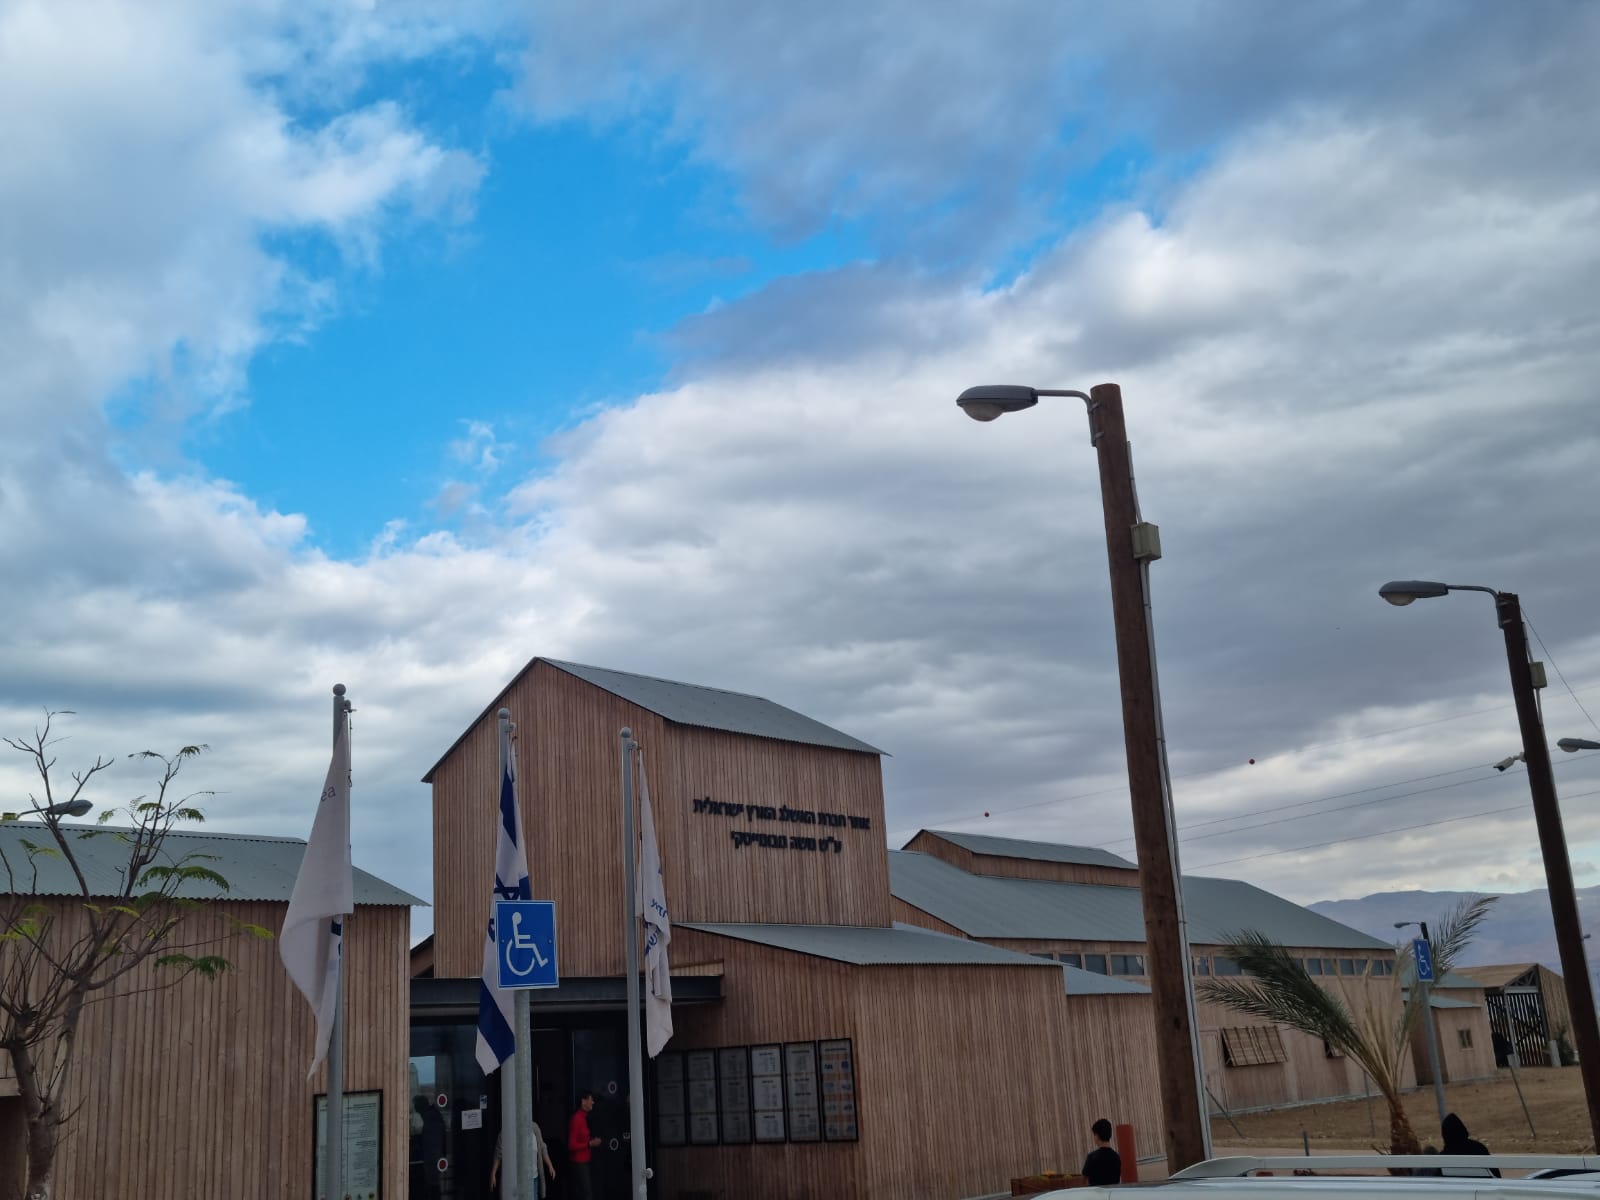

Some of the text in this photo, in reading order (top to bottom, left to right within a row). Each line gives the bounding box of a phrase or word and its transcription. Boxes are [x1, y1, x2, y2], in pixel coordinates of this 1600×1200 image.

[693, 797, 744, 816] ישראלית
[746, 804, 776, 822] הארץ
[778, 804, 816, 824] האשלג
[817, 812, 846, 827] חברת
[789, 836, 816, 851] משה
